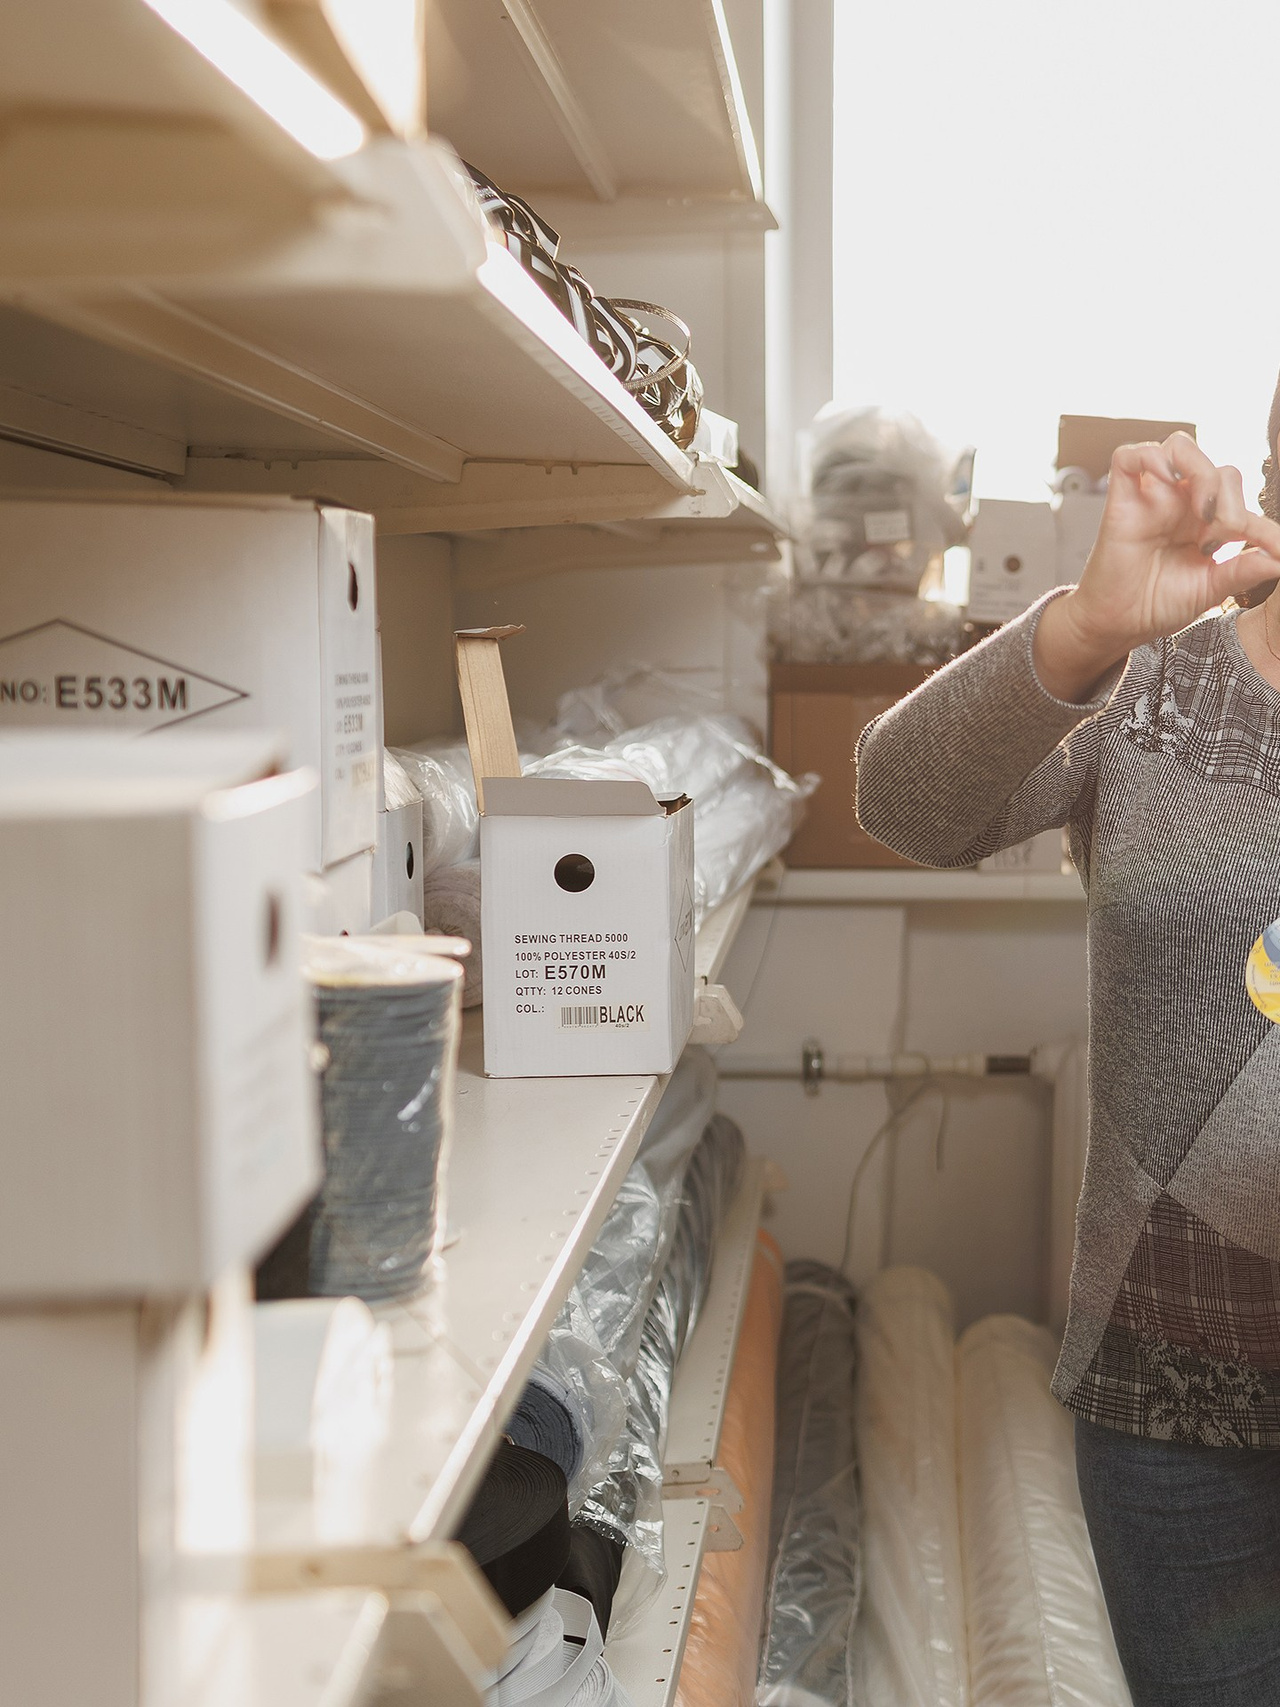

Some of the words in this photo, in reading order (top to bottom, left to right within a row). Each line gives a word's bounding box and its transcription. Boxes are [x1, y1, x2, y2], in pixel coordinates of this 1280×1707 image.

[0, 680, 47, 703] NO:
[55, 675, 188, 711] E533M
[514, 934, 557, 944] SEWING
[559, 933, 603, 943] THREAD
[604, 933, 628, 943] 5000
[515, 952, 541, 961] 100%
[544, 951, 606, 961] POLYESTER
[608, 951, 636, 960] 40S/2
[515, 969, 539, 979] LOT:
[544, 964, 606, 980] E570M
[515, 987, 546, 996] QTTY:
[551, 986, 563, 995] 12
[565, 985, 602, 995] CONES
[516, 1004, 545, 1014] COL.:
[600, 1004, 645, 1023] BLACK
